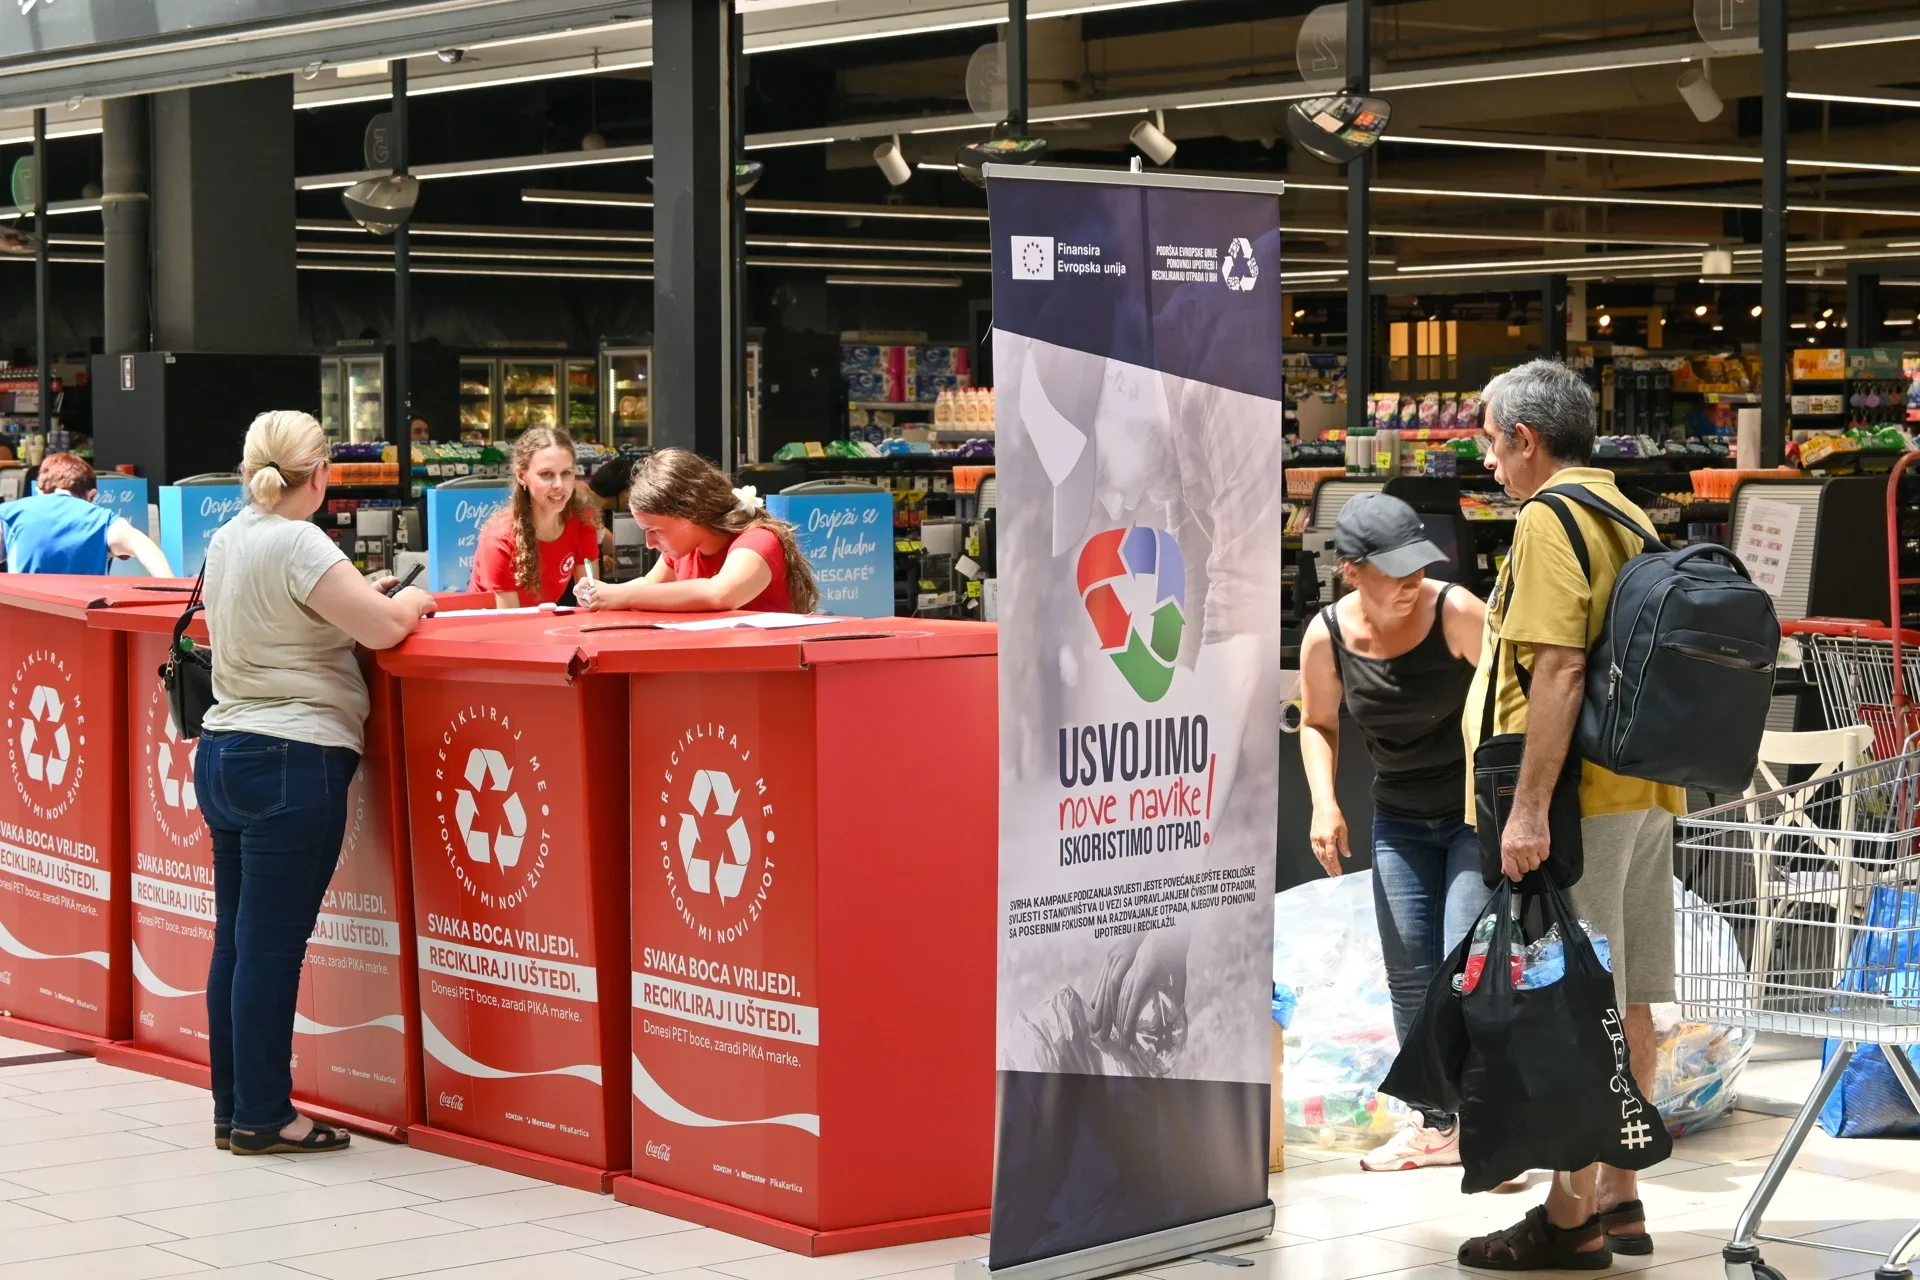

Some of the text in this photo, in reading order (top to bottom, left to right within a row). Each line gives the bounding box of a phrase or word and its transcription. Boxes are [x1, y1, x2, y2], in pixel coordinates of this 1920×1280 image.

[1057, 242, 1100, 256] Finansira
[1057, 260, 1126, 276] Evropska unija
[1156, 244, 1218, 258] PODRŠKA EVROPSKE UNIJE
[1166, 258, 1192, 269] PONOVNOJ
[1191, 259, 1215, 270] UPOTREBI
[1151, 270, 1185, 281] RECIKLIRANJU
[1185, 271, 1204, 282] OTPADA
[1204, 272, 1209, 282] U
[200, 496, 243, 522] Osvjež
[808, 507, 879, 539] Osvježi se
[458, 534, 475, 547] uz
[810, 531, 876, 562] uz hladnu
[827, 586, 859, 600] kafu!
[8, 649, 85, 725] RECIKLIRAJ ME
[436, 704, 547, 791] RECIKLIRAJ ME
[1059, 714, 1208, 788] USVOJIMO
[7, 738, 85, 820] POKLONI MI NOVI ŽIVOT
[661, 722, 774, 817] RECIKLIRAJ ME
[146, 765, 203, 848] POKLONI MI NOVI
[347, 795, 364, 851] ŽIVOT
[1058, 794, 1117, 831] nove
[0, 821, 99, 863] VAKA BOCA VRIJEDI.
[1059, 826, 1153, 867] ISKORISTIMO
[0, 848, 99, 892] ECIKLIRAJ I UŠTEDI.
[137, 852, 164, 875] SVAKA
[165, 859, 192, 881] BOCA
[437, 814, 551, 910] POKLONI MI NOVI ŽIVOT
[13, 881, 24, 894] PET
[25, 885, 42, 900] boce,
[42, 892, 60, 906] zaradi
[60, 895, 76, 911] PIKA
[75, 903, 98, 916] marke.
[137, 881, 187, 910] RECIKLIRAJ
[338, 891, 387, 915] VRIJEDI.
[660, 840, 775, 944] POKLONI MI NOVI ŽIVOT
[1008, 879, 1257, 926] SVIJESTI STANOVNIŠTVA U VEZI SA UPRAVLJANJEM ČVRSTIM OTPADOM,
[1009, 864, 1256, 911] SVRHA KAMPANJE PODIZANJA SVIJESTI JESTE POVEĆANJE OPŠTE EKOLOŠKE
[137, 911, 214, 941] Donesi PET boce, zaradi PIKA
[335, 922, 340, 941] I
[341, 919, 388, 947] UŠTEDI.
[1008, 891, 1256, 939] SA POSEBNIM FOKUSOM NA RAZDVAJANJE OTPADA, NJEGOVU PONOVNU
[1094, 922, 1132, 939] UPOTREBU
[1137, 915, 1176, 932] RECIKLAŽU.
[427, 912, 579, 959] SVAKA BOCA VRIJEDI.
[328, 955, 348, 969] zaradi
[348, 957, 365, 971] PIKA
[365, 961, 389, 975] marke.
[430, 945, 581, 993] RECIKLIRAJ I UŠTEDI.
[643, 946, 801, 998] SVAKA BOCA VRIJEDI.
[431, 979, 583, 1023] Donesi PET boce, zaradi PIKA marke.
[643, 982, 802, 1036] RECIKLIRAJ I UŠTEDI.
[643, 1019, 802, 1068] Donesi PET boce, zaradi PIKA marke.
[531, 1117, 556, 1130] Mercator
[559, 1123, 590, 1138] PikaKartica
[740, 1170, 766, 1184] Mercator
[769, 1177, 803, 1193] PikaKartica
